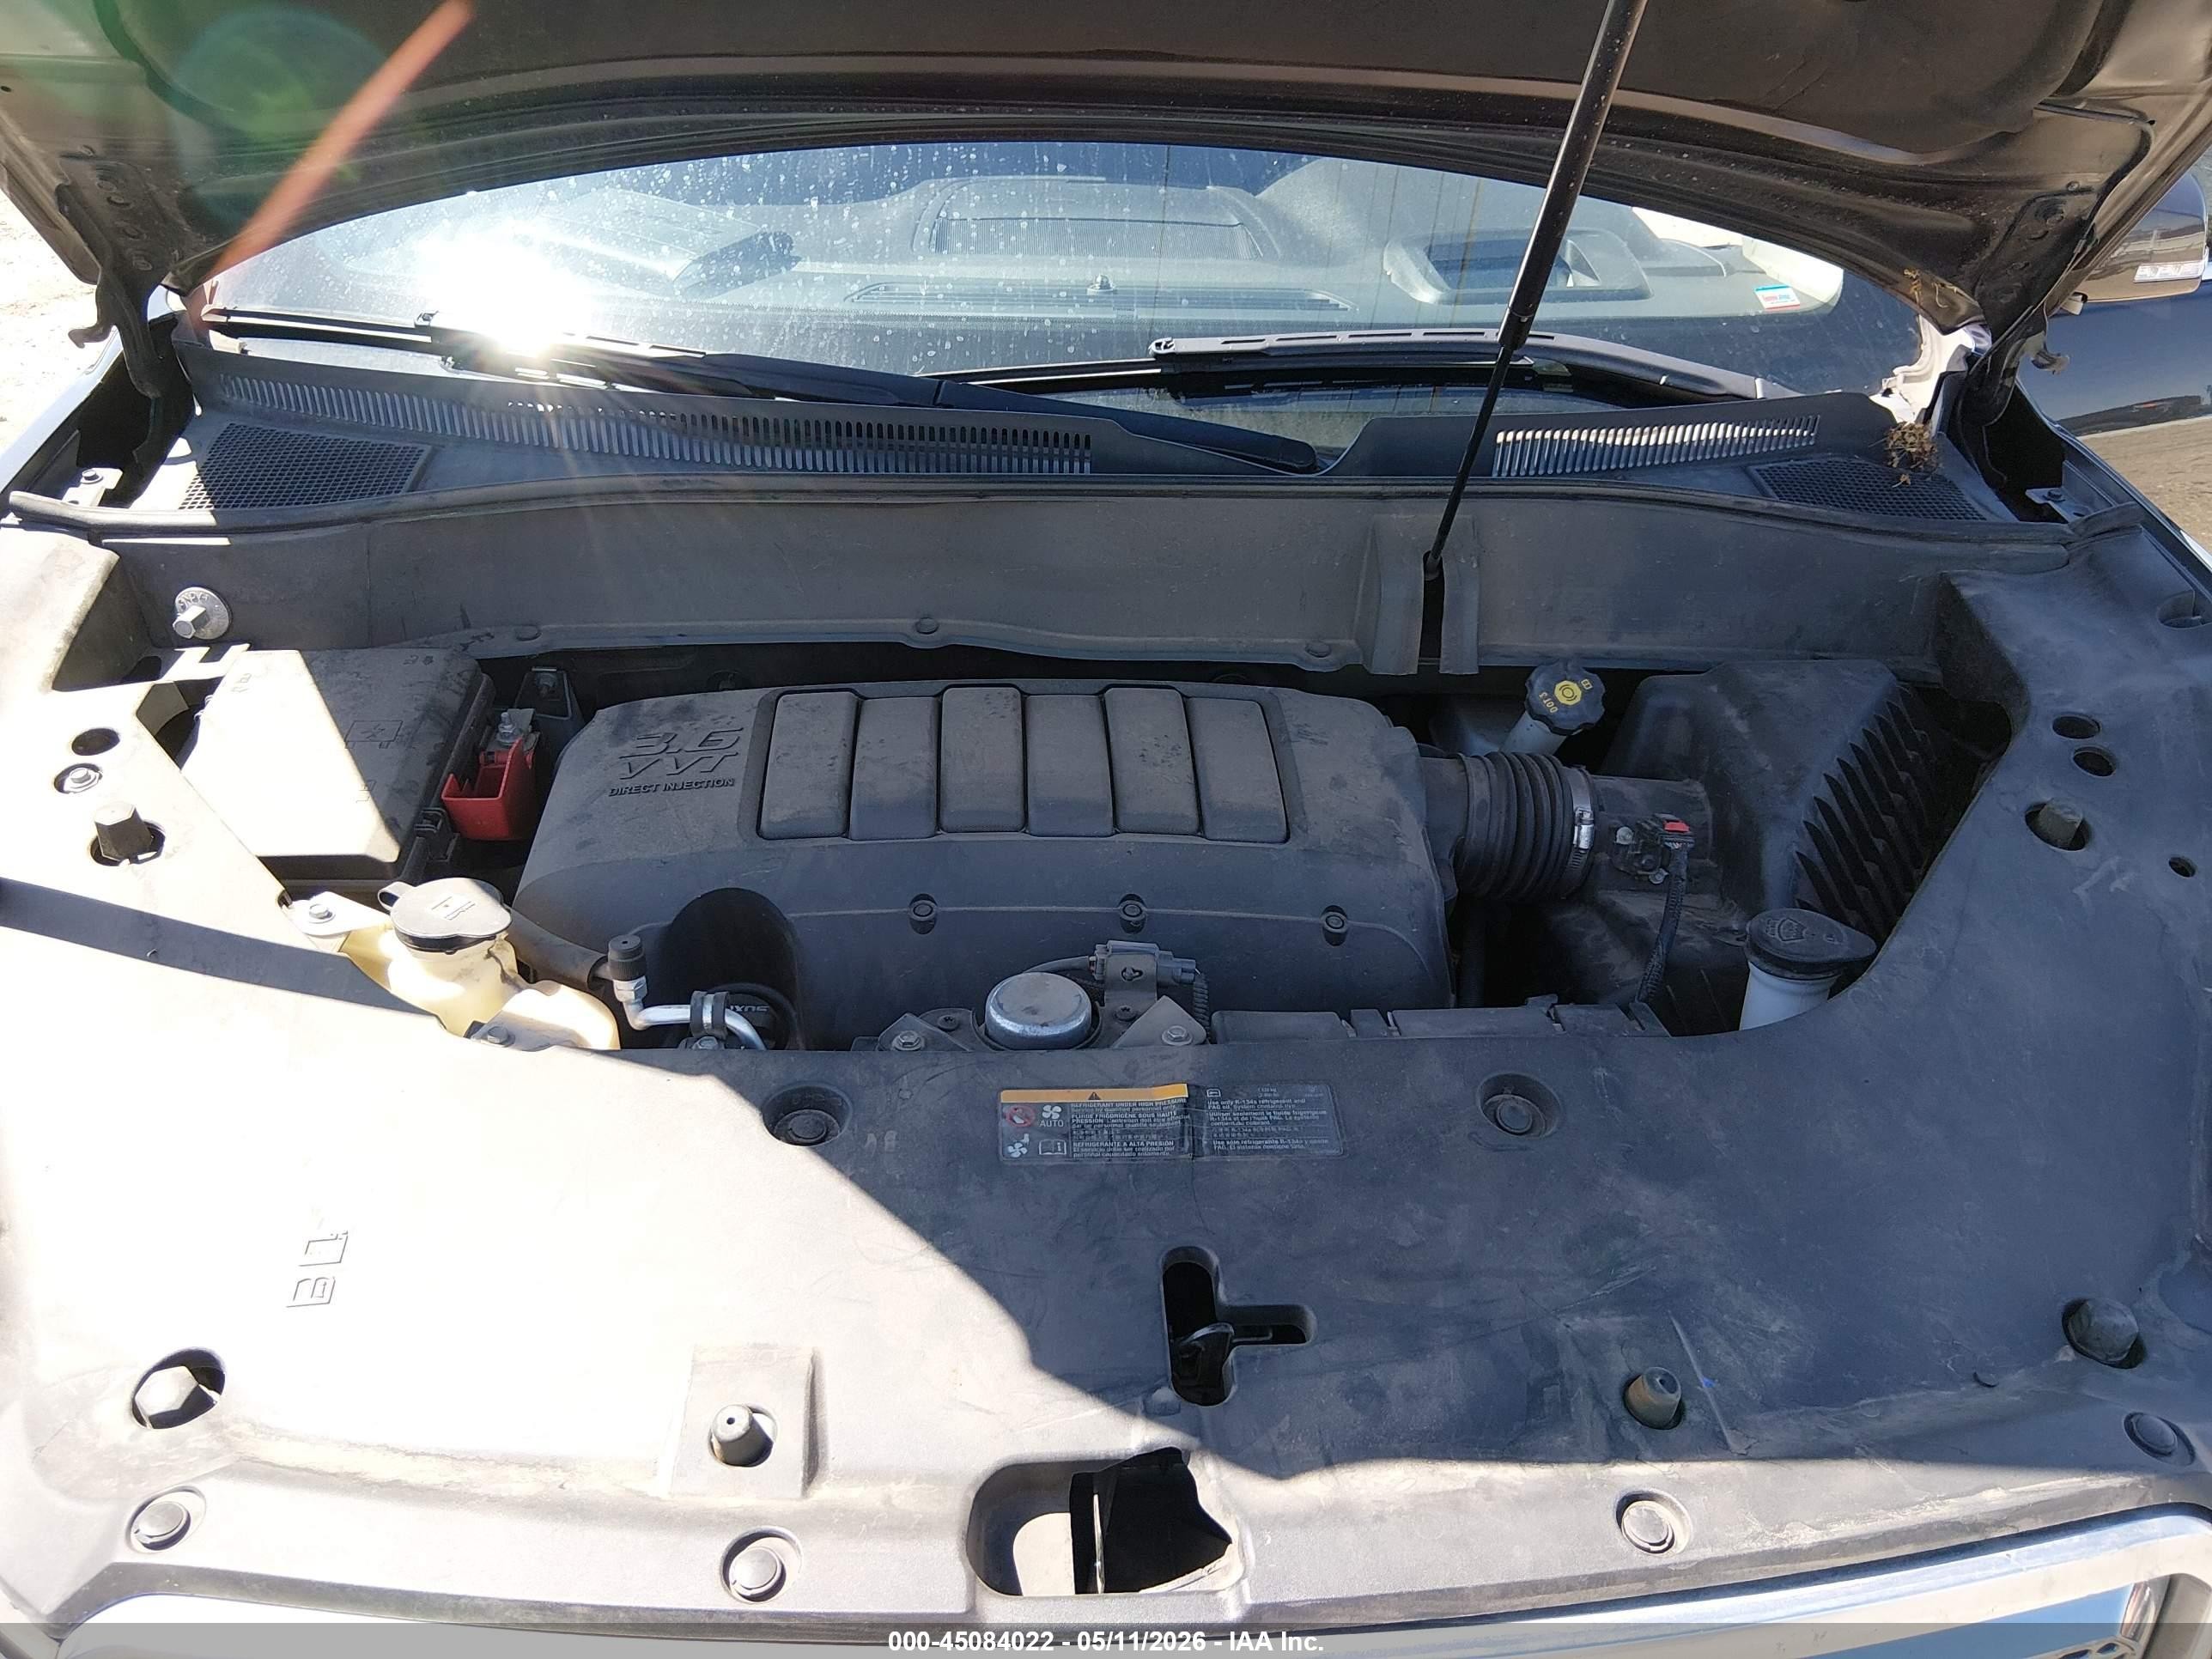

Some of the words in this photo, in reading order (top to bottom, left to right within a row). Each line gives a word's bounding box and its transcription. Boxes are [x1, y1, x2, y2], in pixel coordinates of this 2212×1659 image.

[618, 727, 744, 759] 3.6
[618, 752, 739, 780] VVT
[608, 783, 660, 797] DIRECT
[662, 777, 735, 792] INJECTION
[1039, 1119, 1064, 1127] AUTO
